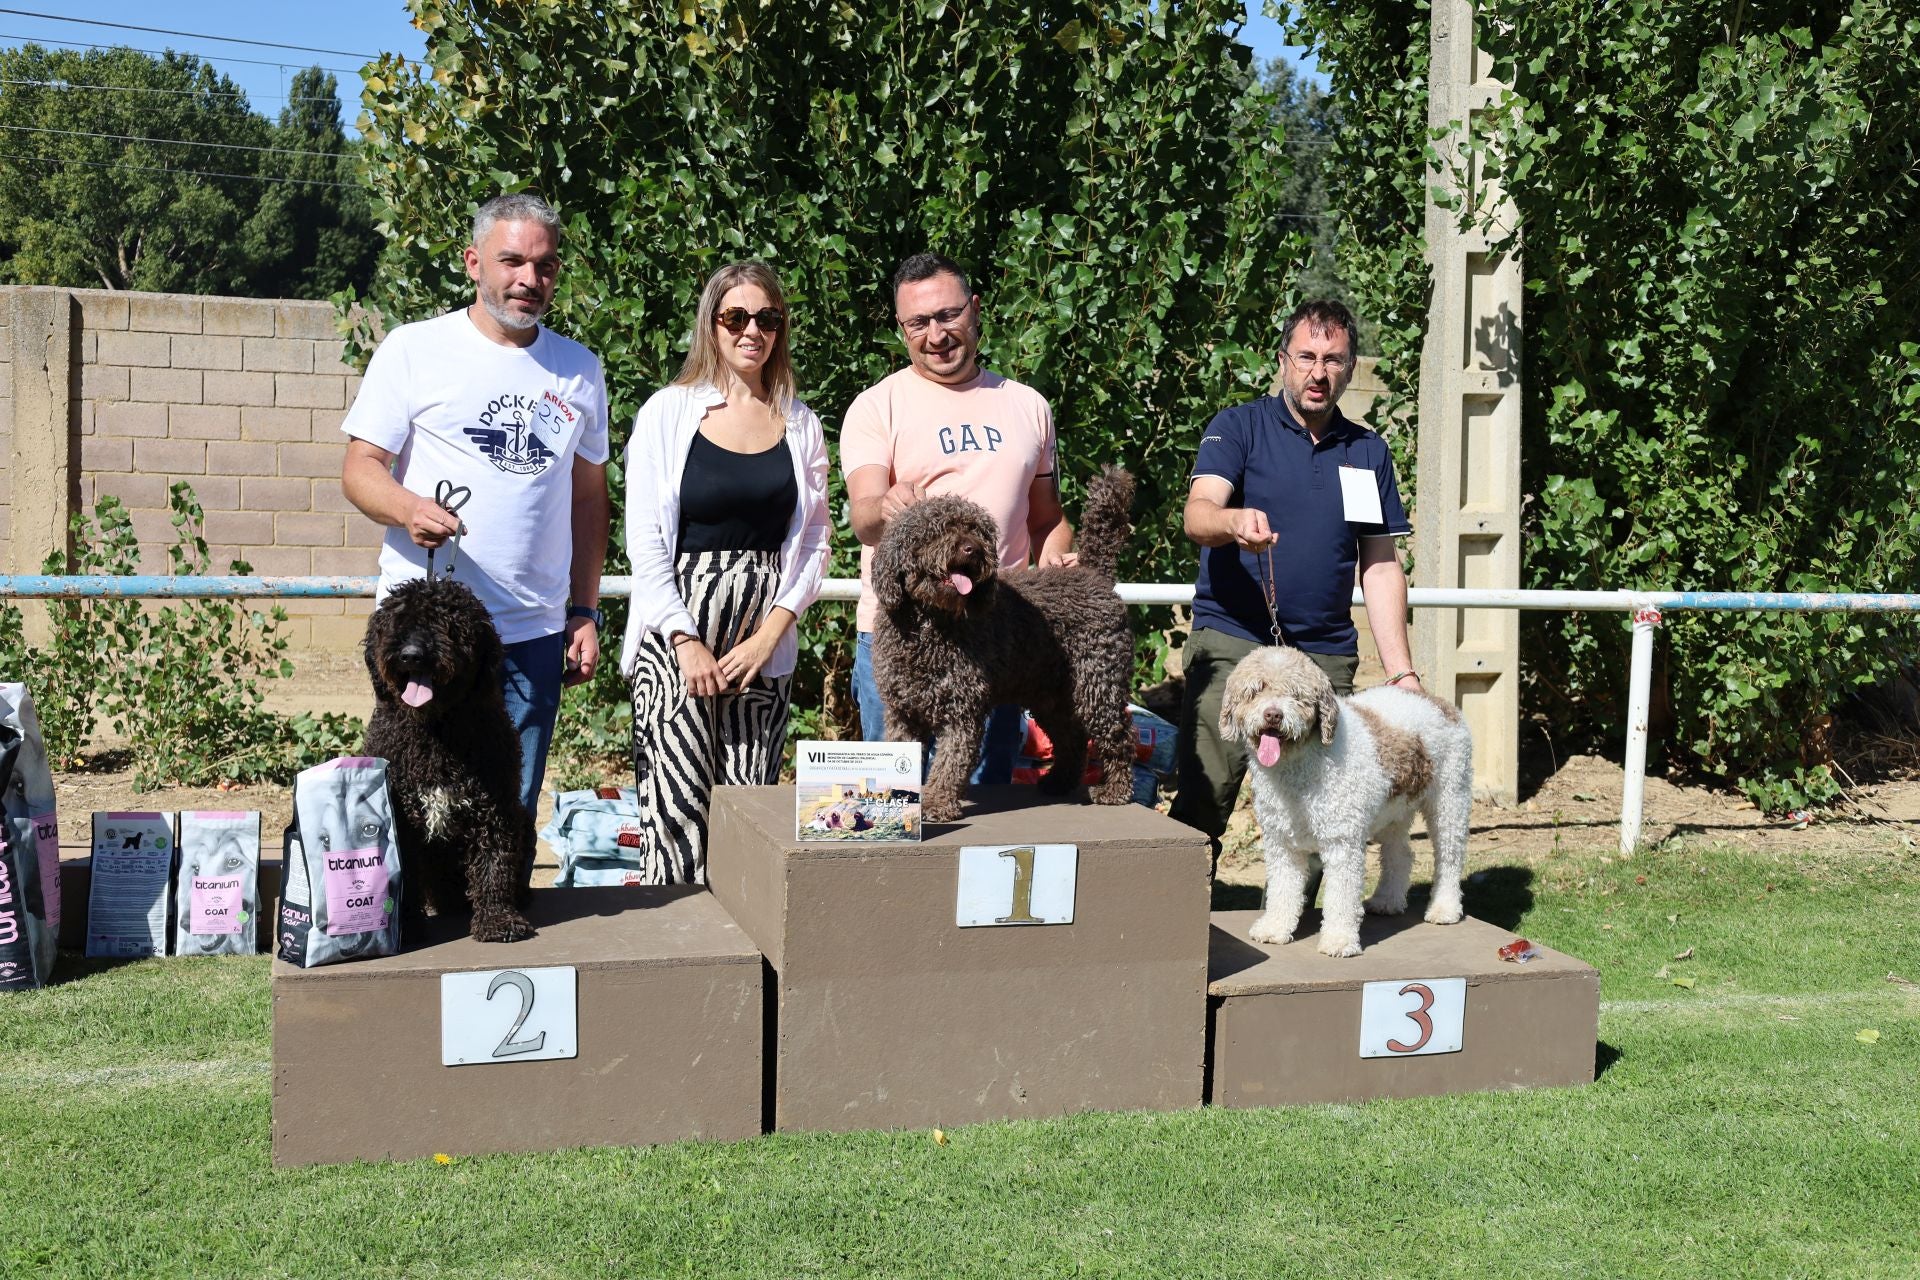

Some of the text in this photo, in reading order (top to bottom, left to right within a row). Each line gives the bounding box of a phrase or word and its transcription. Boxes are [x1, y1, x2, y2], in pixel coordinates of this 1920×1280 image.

[479, 394, 538, 426] DOCKE
[544, 391, 575, 422] ARION
[939, 424, 1003, 455] GAP
[807, 752, 826, 763] VII
[875, 798, 909, 808] CLASE
[328, 855, 384, 872] titanium
[195, 880, 239, 890] titanium
[995, 846, 1045, 924] 1
[205, 908, 228, 916] COAT
[346, 896, 374, 909] COAT
[486, 970, 547, 1058] 2
[1386, 982, 1435, 1053] 3
